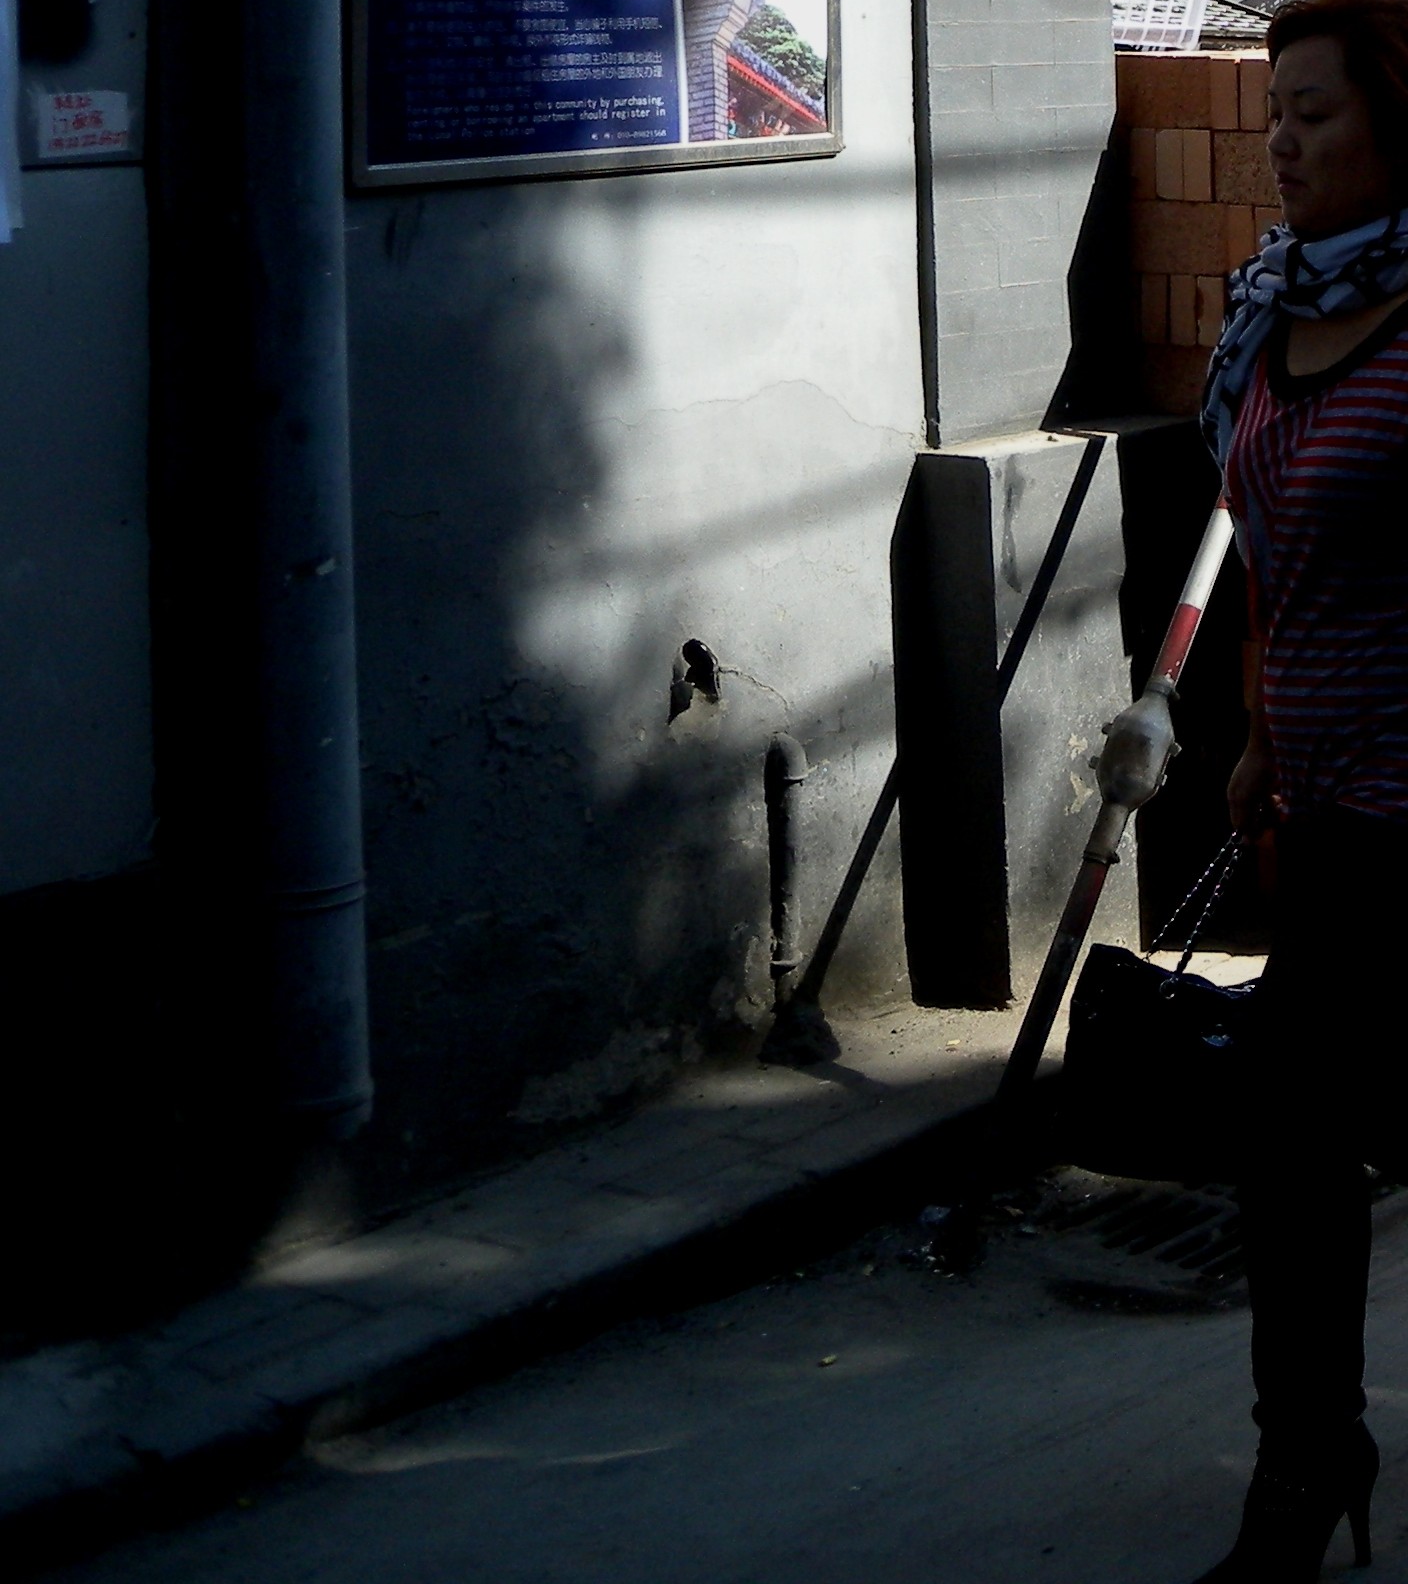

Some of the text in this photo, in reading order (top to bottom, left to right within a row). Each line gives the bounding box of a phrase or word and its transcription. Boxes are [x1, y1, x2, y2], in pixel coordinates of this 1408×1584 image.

[600, 97, 610, 109] by
[579, 109, 608, 120] should
[611, 108, 650, 122] register
[656, 106, 666, 117] in
